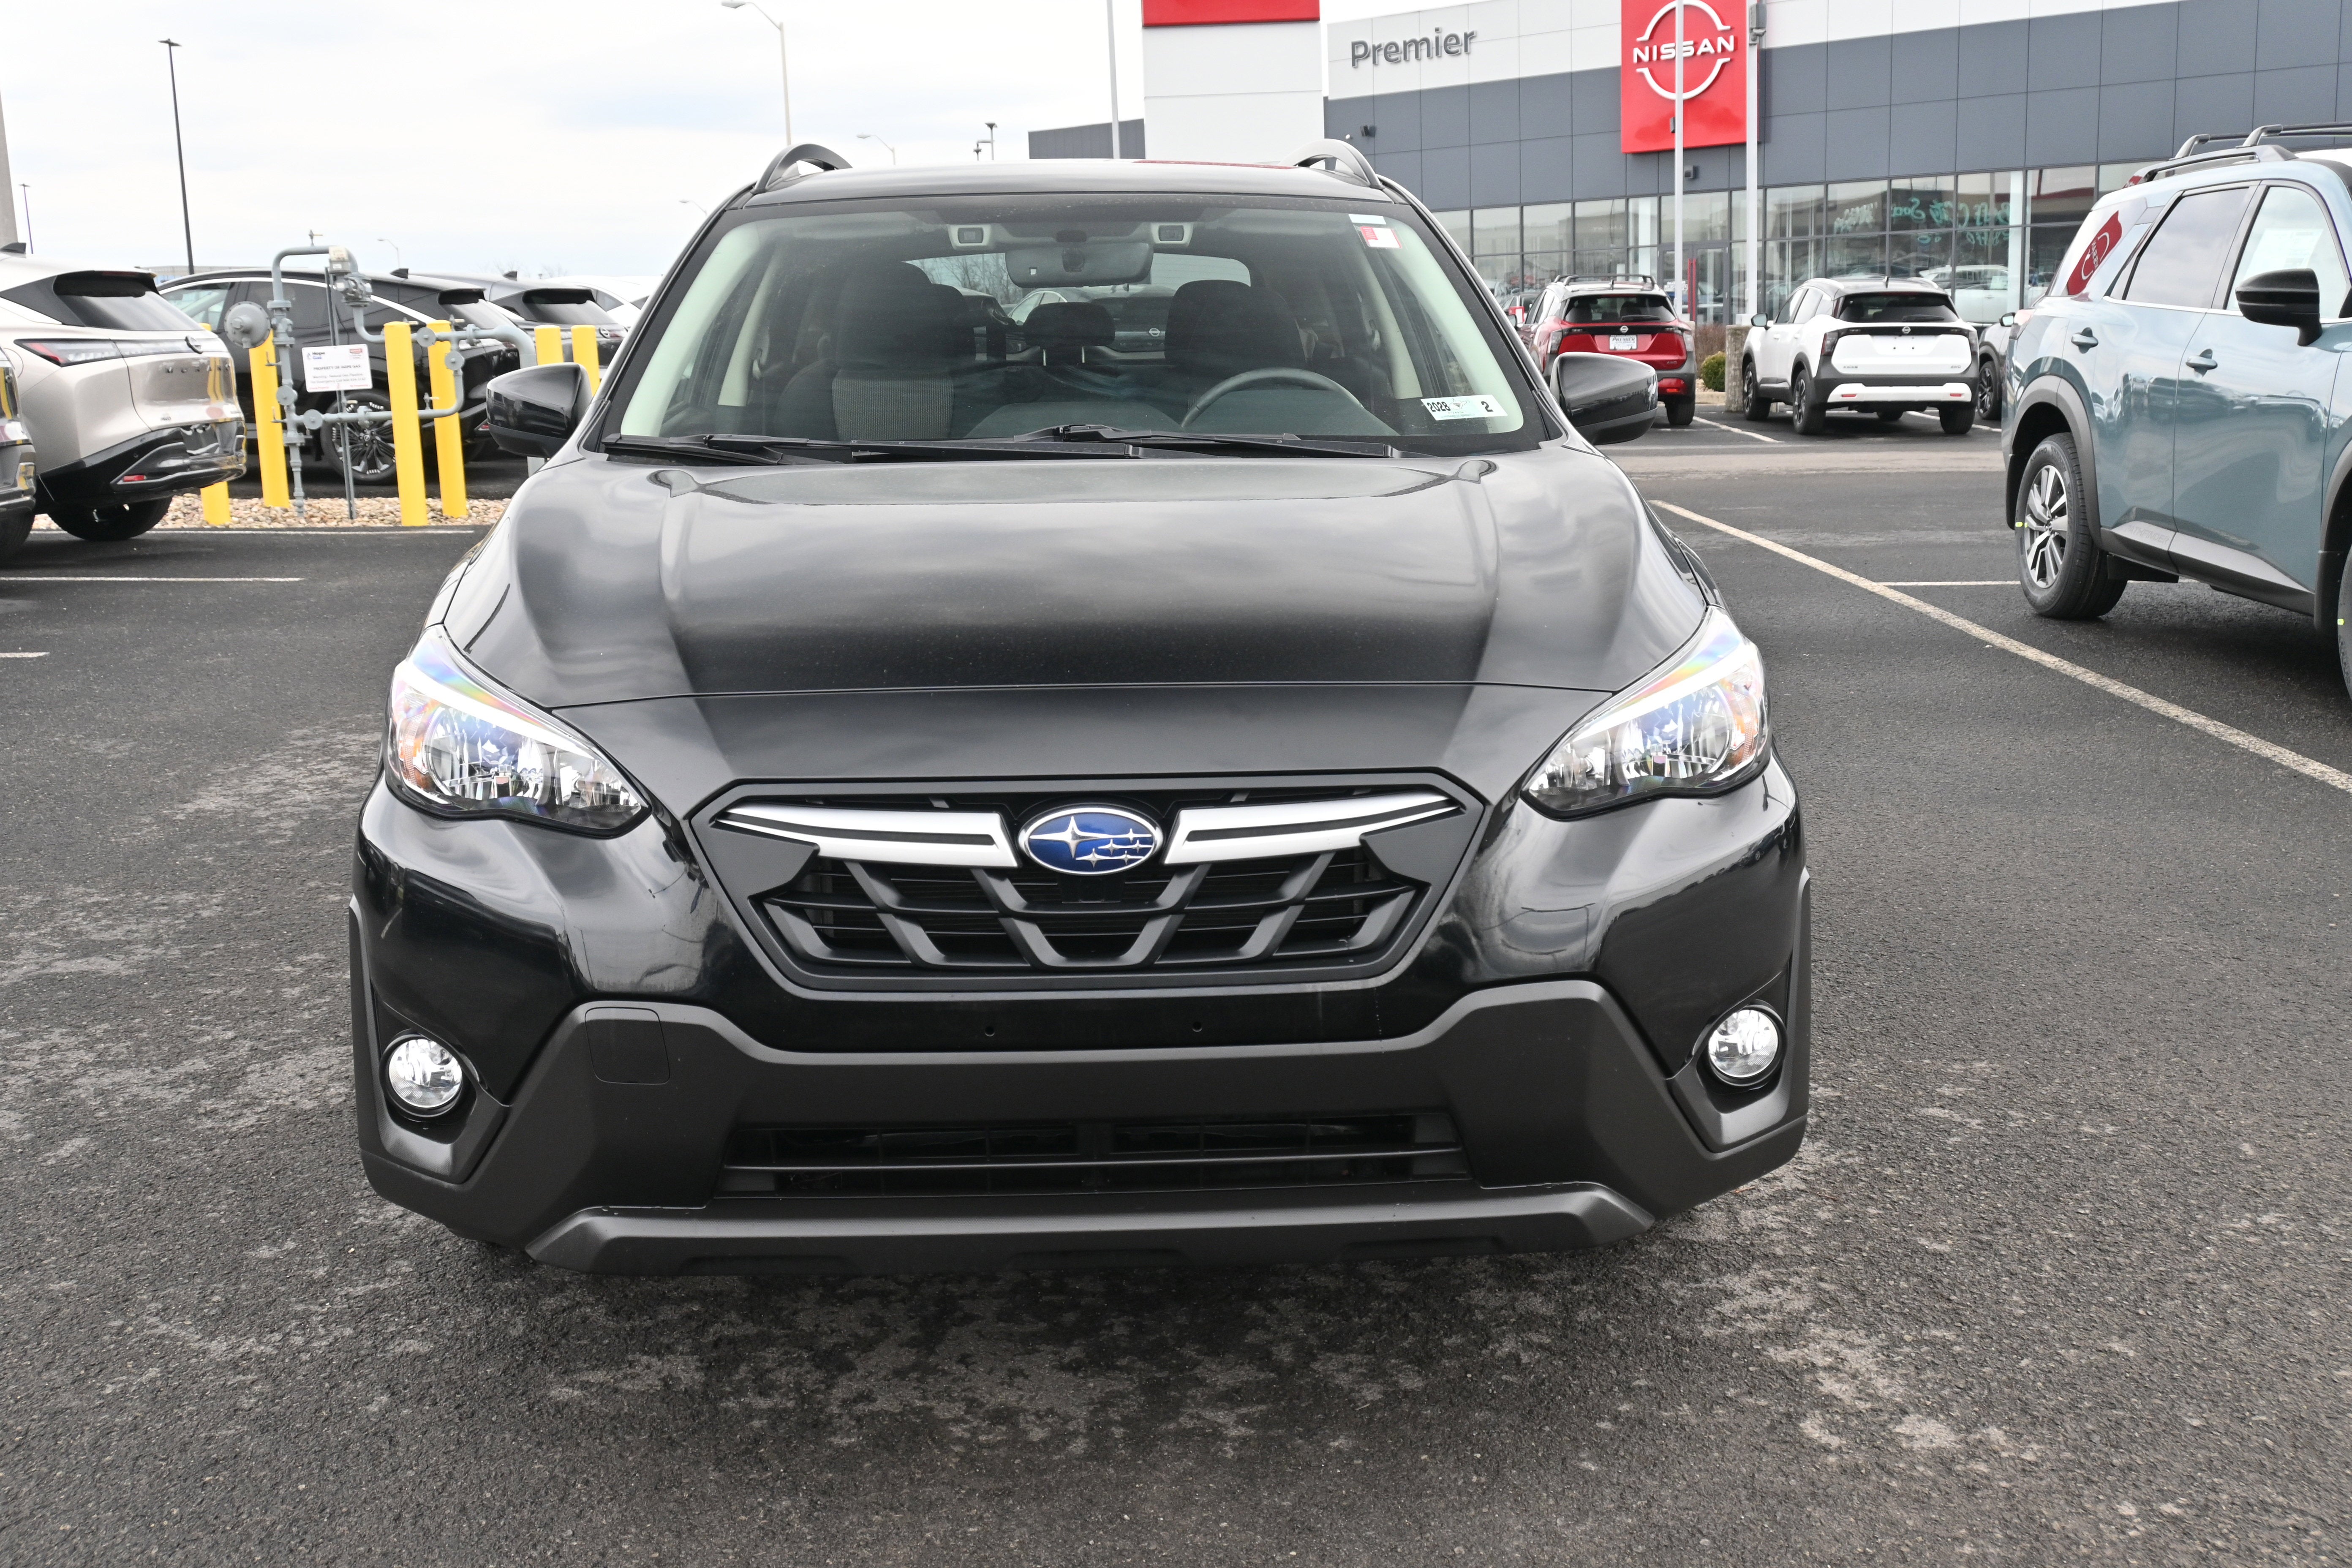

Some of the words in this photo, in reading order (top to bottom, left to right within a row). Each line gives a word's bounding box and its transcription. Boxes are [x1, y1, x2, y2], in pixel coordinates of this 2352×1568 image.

[1351, 27, 1477, 67] Premier
[1633, 35, 1734, 63] NISSAN
[1427, 402, 1451, 412] 2028
[1481, 401, 1494, 412] 2
